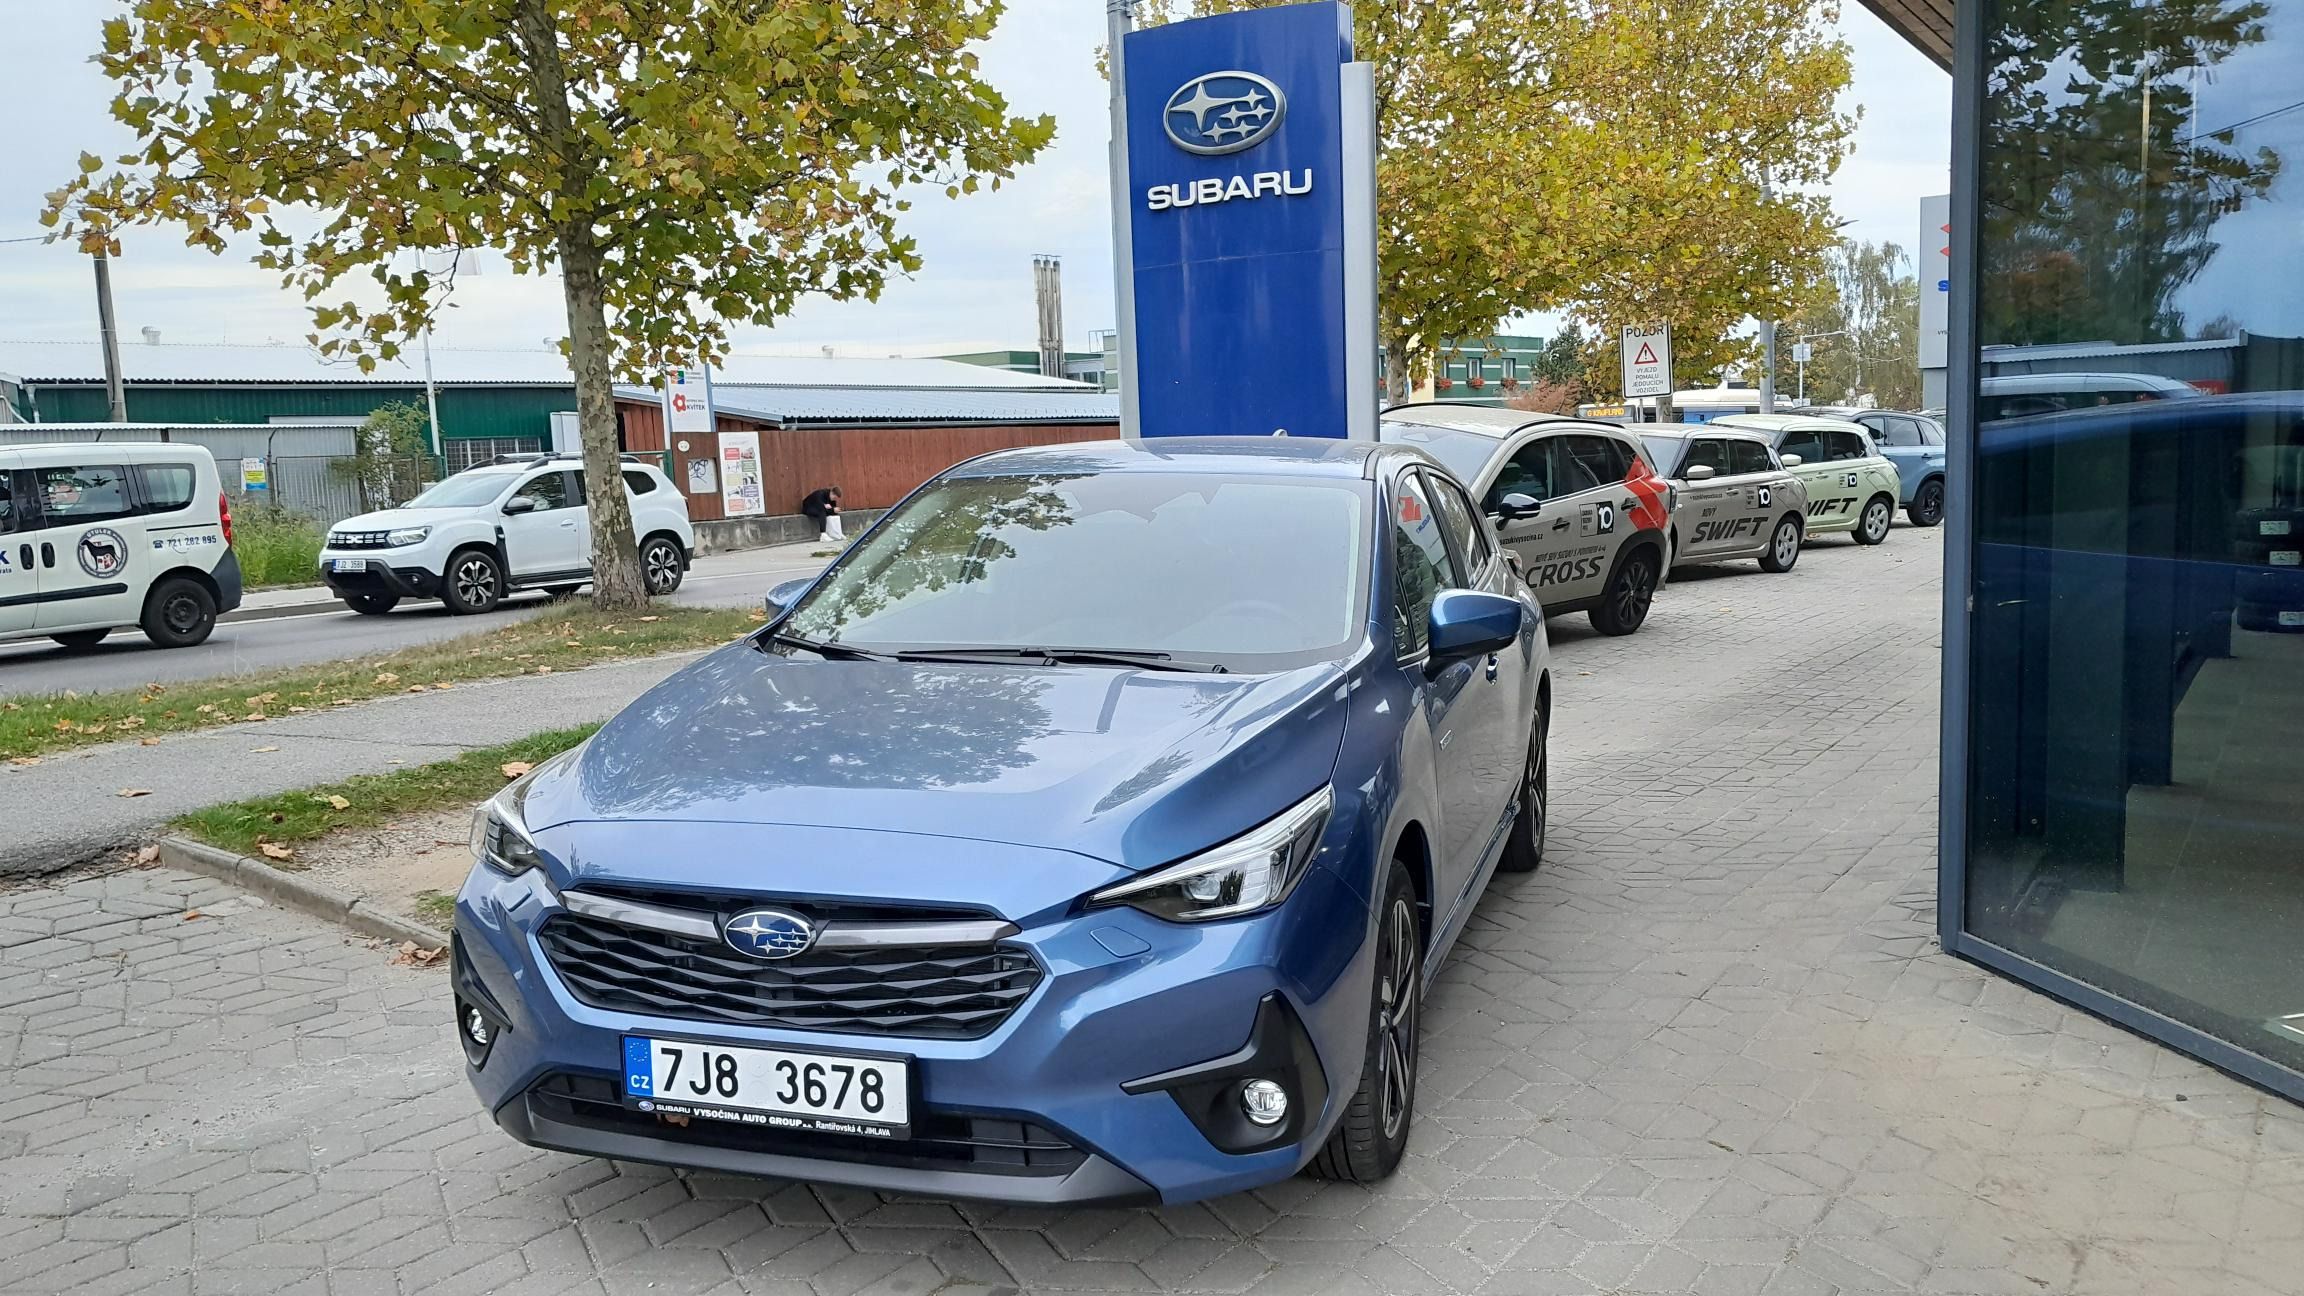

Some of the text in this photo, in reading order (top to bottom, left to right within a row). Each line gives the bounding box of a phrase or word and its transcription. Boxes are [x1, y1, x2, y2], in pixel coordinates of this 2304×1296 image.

[1147, 168, 1313, 210] SUBARU
[1626, 325, 1664, 338] POZOR
[167, 535, 217, 547] 721 282 895
[1690, 516, 1769, 543] SWIFT
[1525, 555, 1605, 588] CROSS
[631, 1074, 650, 1089] CZ
[660, 1047, 885, 1114] 7J8 3678
[656, 1104, 691, 1114] SUBARU
[693, 1108, 740, 1121] VYSOČINA
[742, 1113, 767, 1124] AUTO
[768, 1116, 803, 1127] GROUP
[864, 1126, 891, 1137] JIHLAVA
